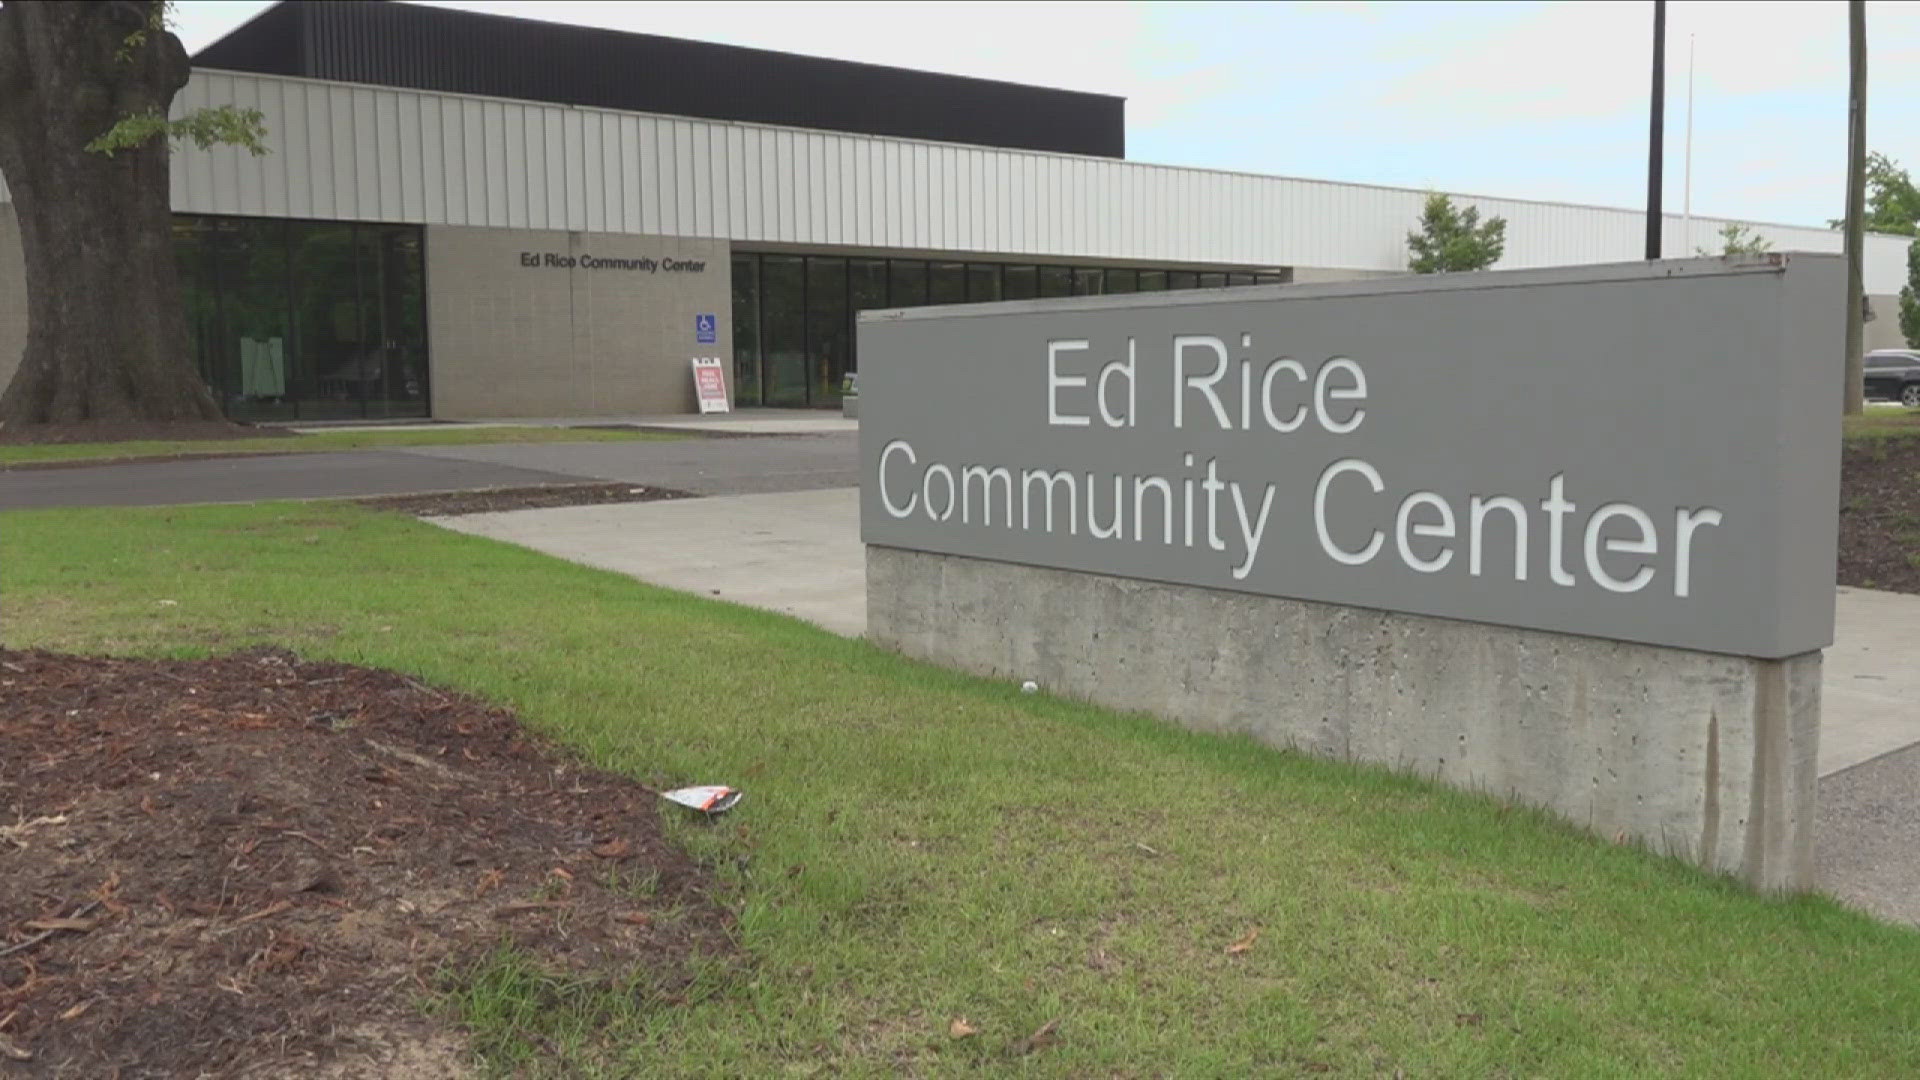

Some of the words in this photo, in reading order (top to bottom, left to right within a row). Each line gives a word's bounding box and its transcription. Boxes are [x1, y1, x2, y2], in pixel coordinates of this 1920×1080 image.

[521, 252, 540, 267] Ed
[544, 253, 576, 269] Rice
[580, 254, 658, 274] Community
[662, 257, 706, 273] Center
[1047, 339, 1137, 428] Ed
[1173, 334, 1367, 434] Rice
[879, 441, 1276, 580] Community
[1314, 460, 1722, 598] Center
